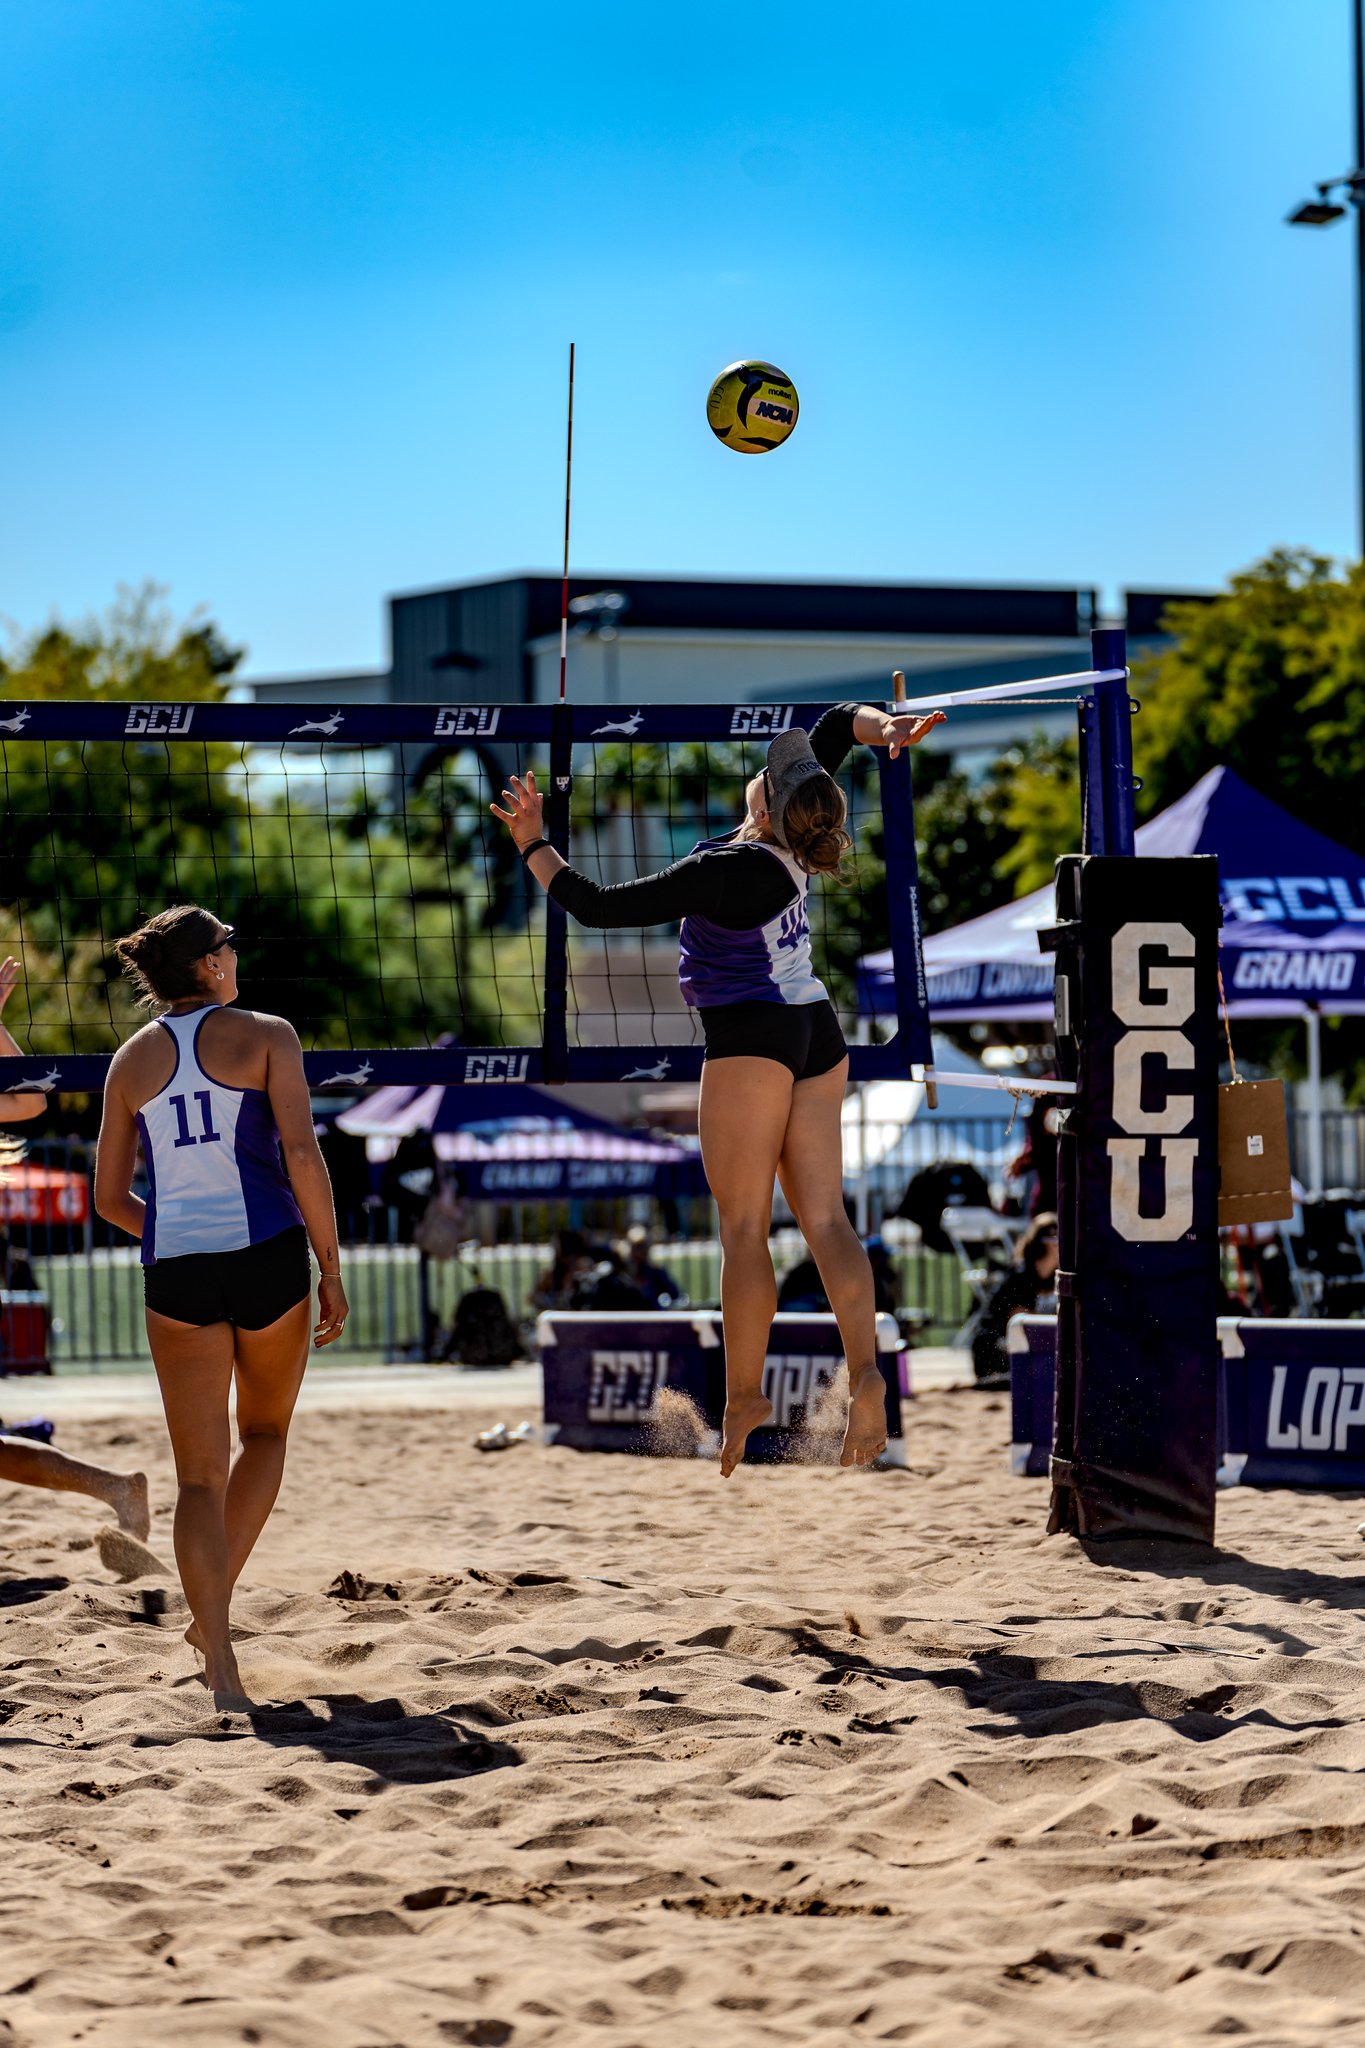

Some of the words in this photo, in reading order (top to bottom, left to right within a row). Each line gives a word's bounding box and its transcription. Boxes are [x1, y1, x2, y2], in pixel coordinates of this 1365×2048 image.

[124, 705, 195, 734] GCU
[434, 707, 501, 736] GCU
[730, 706, 794, 734] GCU
[1221, 876, 1365, 922] GCU
[1232, 951, 1357, 990] GRAND
[463, 1055, 530, 1083] GCU
[1107, 922, 1199, 1242] GCU
[169, 1090, 220, 1148] 11
